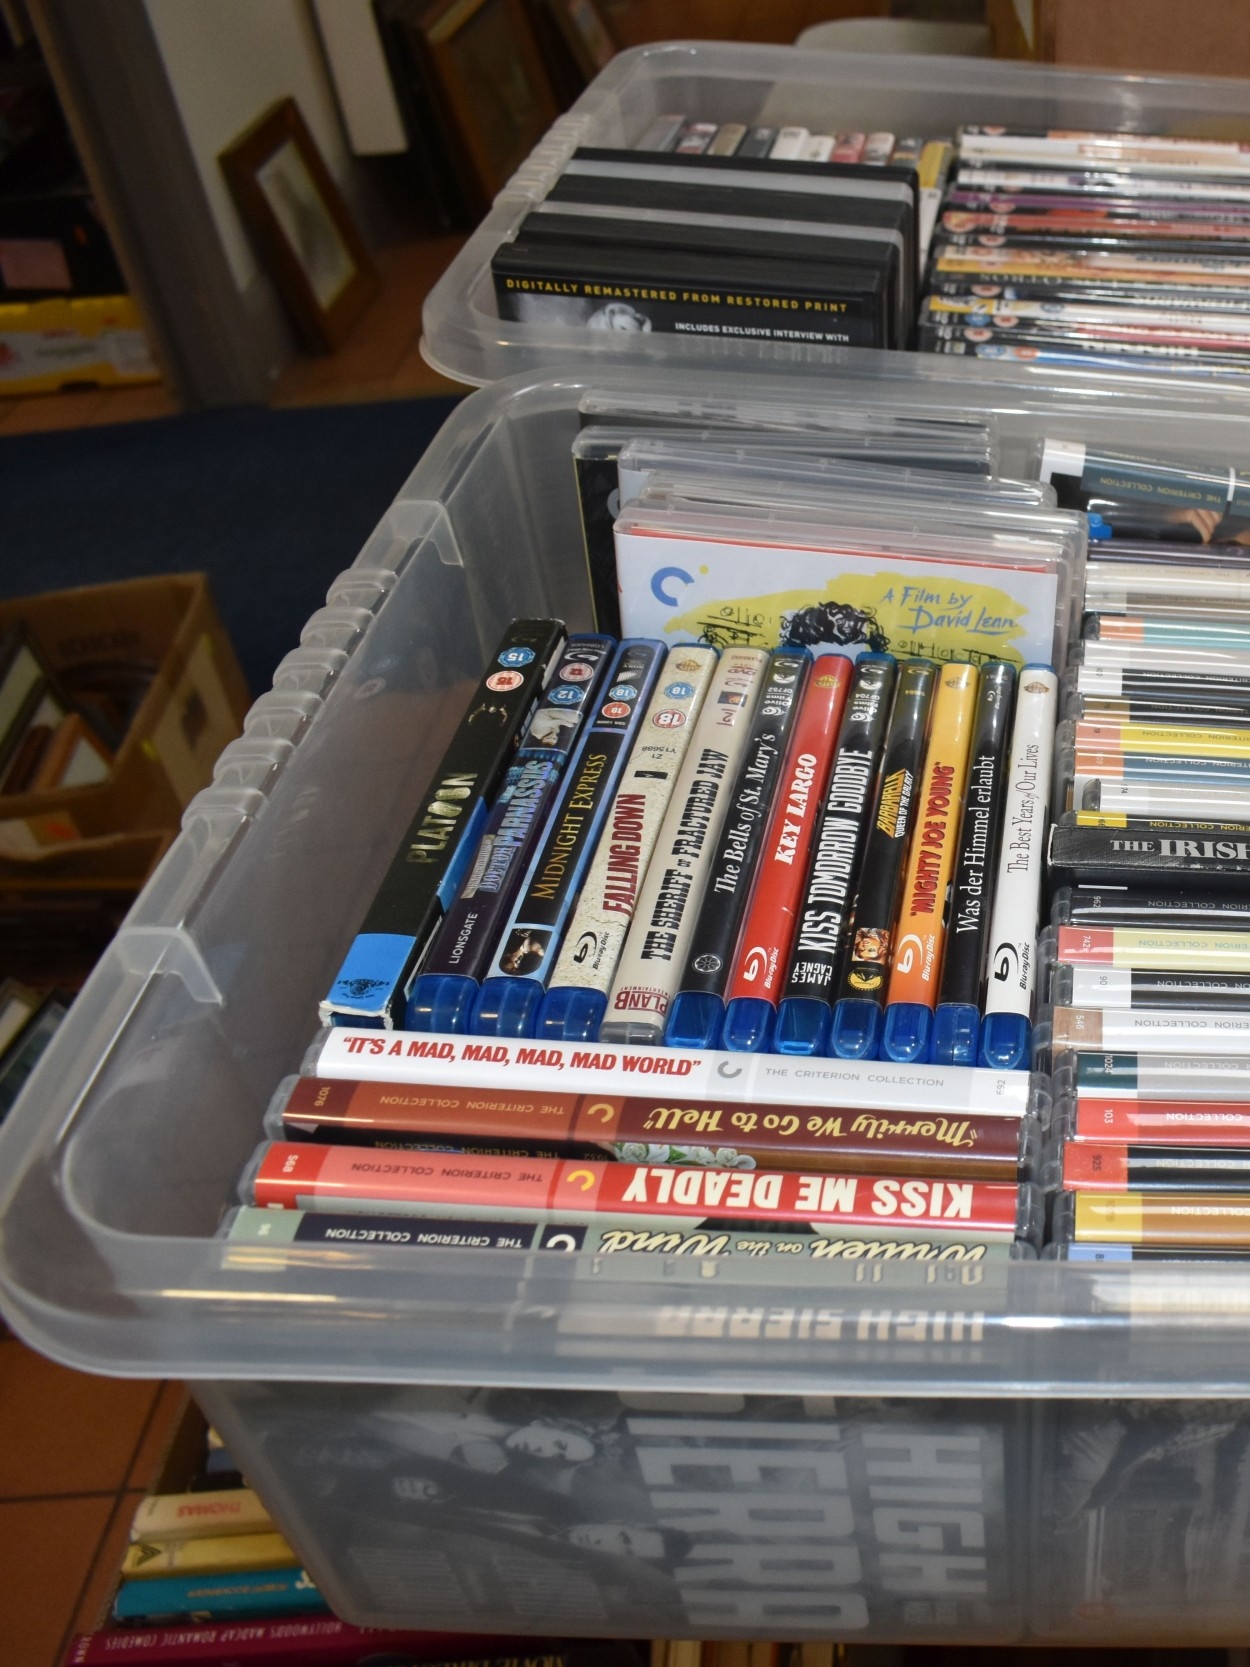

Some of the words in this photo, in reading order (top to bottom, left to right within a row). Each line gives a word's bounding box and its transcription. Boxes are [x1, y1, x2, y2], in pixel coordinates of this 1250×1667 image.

[506, 278, 580, 294] DIGITALLY
[584, 285, 678, 301] REMASTERED
[683, 293, 721, 304] FROM
[727, 295, 799, 309] RESTORED
[804, 301, 848, 313] PRINT
[675, 322, 720, 333] INCLUDES
[722, 325, 772, 336] EXCLUSIVE
[773, 329, 824, 339] INTERVIEW
[825, 332, 850, 342] WITH
[880, 587, 894, 604] A
[901, 587, 943, 605] Film
[948, 591, 973, 610] by
[909, 605, 970, 633] David
[973, 613, 1018, 635] Lean
[696, 748, 729, 779] JAW
[746, 733, 778, 786] Mary's
[740, 780, 762, 806] St.
[786, 754, 817, 818] LARGO
[828, 748, 872, 813] GOODBYE
[981, 755, 995, 803] erlaubt
[612, 794, 647, 842] DOWN
[742, 803, 761, 824] of
[877, 768, 907, 839] BARBARELLA
[530, 807, 585, 900] MIDNIGHT
[579, 753, 608, 811] EXPRESS
[672, 780, 719, 859] FRACTURED
[724, 822, 752, 863] Bells
[775, 819, 802, 865] KEY
[921, 822, 946, 849] JOE
[964, 804, 990, 867] Himmel
[1110, 839, 1155, 852] THE
[678, 858, 690, 868] OF
[808, 815, 863, 905] TOMORROW
[603, 842, 642, 916] FALLING
[714, 865, 741, 894] The
[968, 870, 983, 896] der
[651, 868, 693, 930] SHERIFF
[798, 910, 842, 954] KISS
[956, 900, 980, 934] Was
[449, 912, 478, 964] LIONSGATE
[641, 931, 676, 961] THE
[792, 972, 831, 986] JAMES
[793, 962, 833, 975] CAGNEY
[343, 1036, 386, 1055] "IT'S
[388, 1040, 402, 1056] A
[407, 1041, 455, 1063] MAD,
[461, 1045, 510, 1067] MAD,
[516, 1048, 564, 1071] MAD,
[570, 1051, 616, 1070] MAD
[621, 1055, 701, 1076] WORLD"
[766, 1068, 787, 1077] THE
[795, 1070, 860, 1081] CRITERION
[867, 1075, 944, 1087] COLLECTION
[996, 1079, 1006, 1096] 692
[314, 1086, 330, 1107] 1076
[643, 1107, 723, 1132] Hell"
[732, 1111, 757, 1133] to
[763, 1114, 800, 1136] Go
[808, 1115, 847, 1138] We
[852, 1114, 978, 1148] "Merrily
[1104, 1109, 1114, 1125] 103
[621, 1167, 783, 1210] DEADLY
[794, 1175, 857, 1213] ME
[872, 1182, 974, 1219] KISS
[325, 1228, 411, 1243] COLLECTION
[417, 1232, 490, 1247] CRITERION
[497, 1237, 522, 1248] THE
[176, 1501, 242, 1518] THOMAS
[105, 1633, 157, 1650] COMEDIES
[162, 1631, 215, 1646] ROMANTIC
